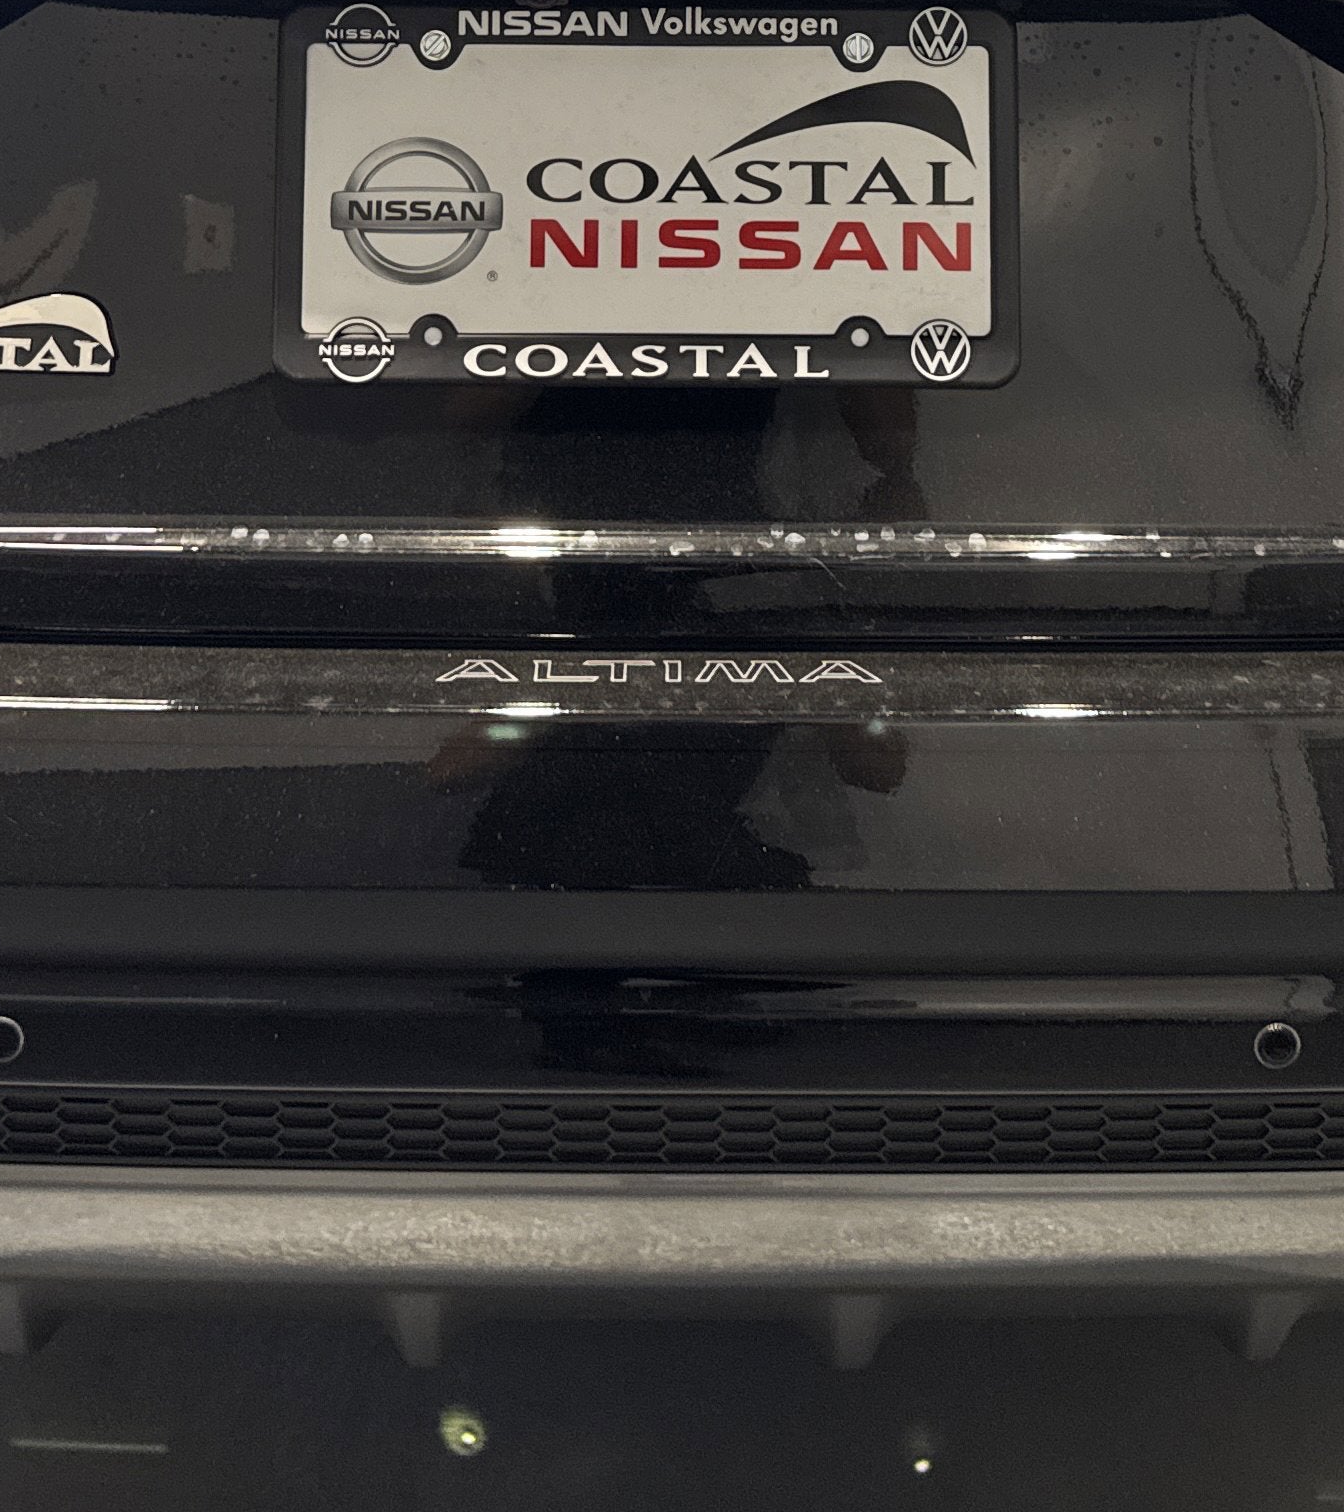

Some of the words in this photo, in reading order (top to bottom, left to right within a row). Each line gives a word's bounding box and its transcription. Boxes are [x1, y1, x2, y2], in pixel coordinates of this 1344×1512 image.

[325, 27, 400, 41] NISSAN
[457, 9, 628, 37] NISSAN
[640, 7, 839, 43] Volkswagen
[526, 156, 975, 206] COASTAL
[347, 199, 486, 223] NISSAN
[528, 219, 972, 273] NISSAN
[318, 343, 395, 357] NISSAN
[462, 343, 830, 379] COASTAL
[436, 659, 883, 682] ALTIMA
